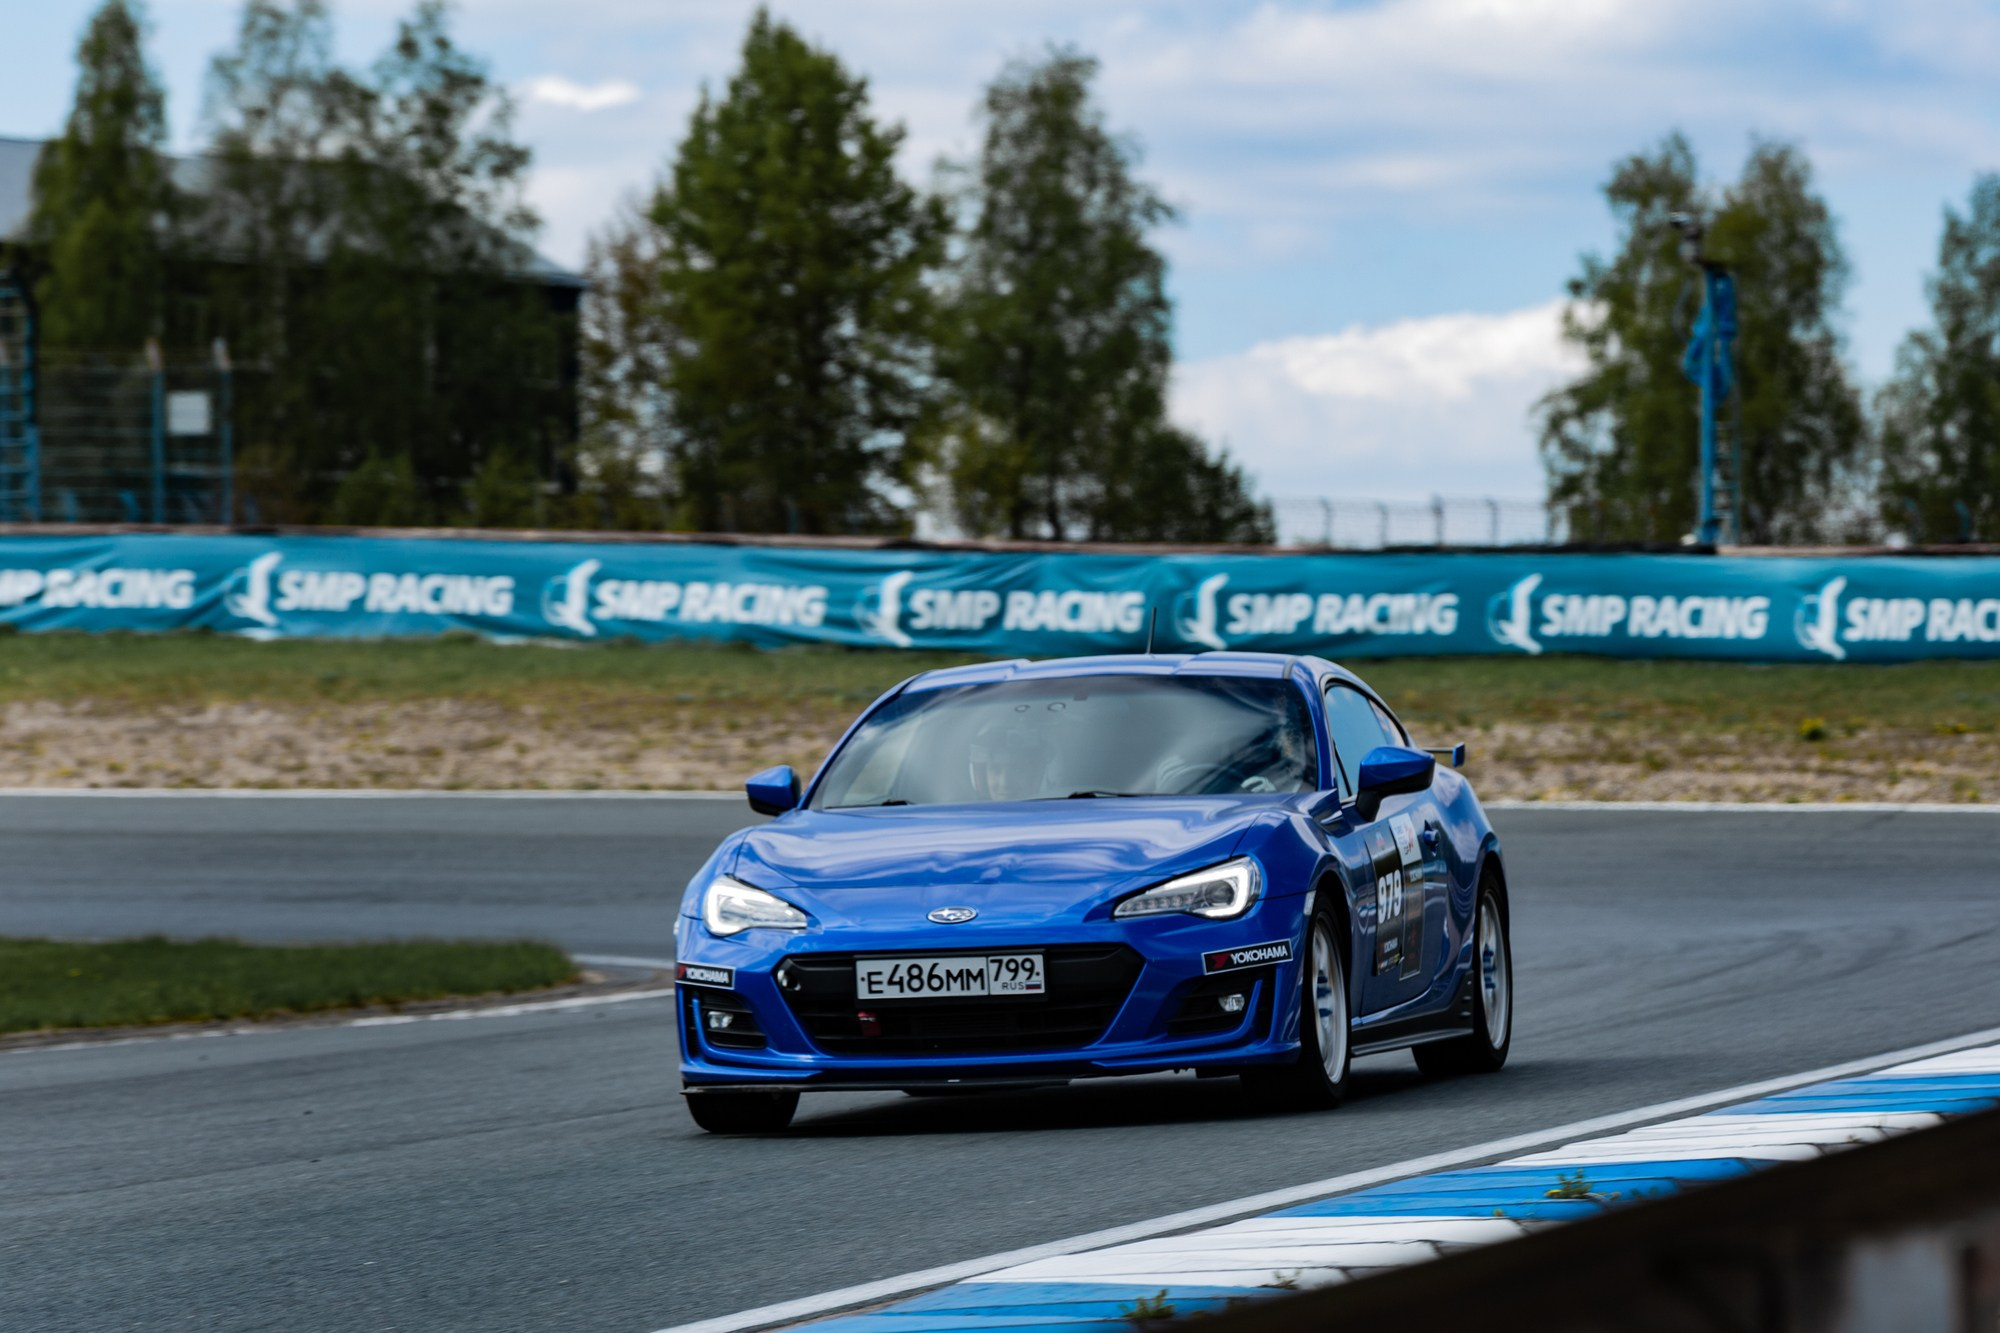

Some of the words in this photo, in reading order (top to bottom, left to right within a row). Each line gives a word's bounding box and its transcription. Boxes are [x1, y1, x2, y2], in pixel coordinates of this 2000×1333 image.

[276, 570, 367, 612] SMP
[364, 572, 516, 616] RACING
[592, 579, 682, 621] SMP
[678, 581, 828, 627] RACING
[908, 589, 1000, 631] SMP
[1002, 590, 1146, 633] RACING
[1225, 592, 1313, 635] SMP
[1312, 592, 1459, 636] RACING
[1539, 593, 1626, 637] SMP
[1627, 595, 1770, 640] RACING
[1842, 596, 1926, 642] SMP
[1925, 598, 2000, 643] RAC
[1378, 869, 1401, 924] 979
[990, 957, 1036, 982] 799
[1230, 945, 1288, 965] YOKOHAMA
[1002, 982, 1024, 991] RUS
